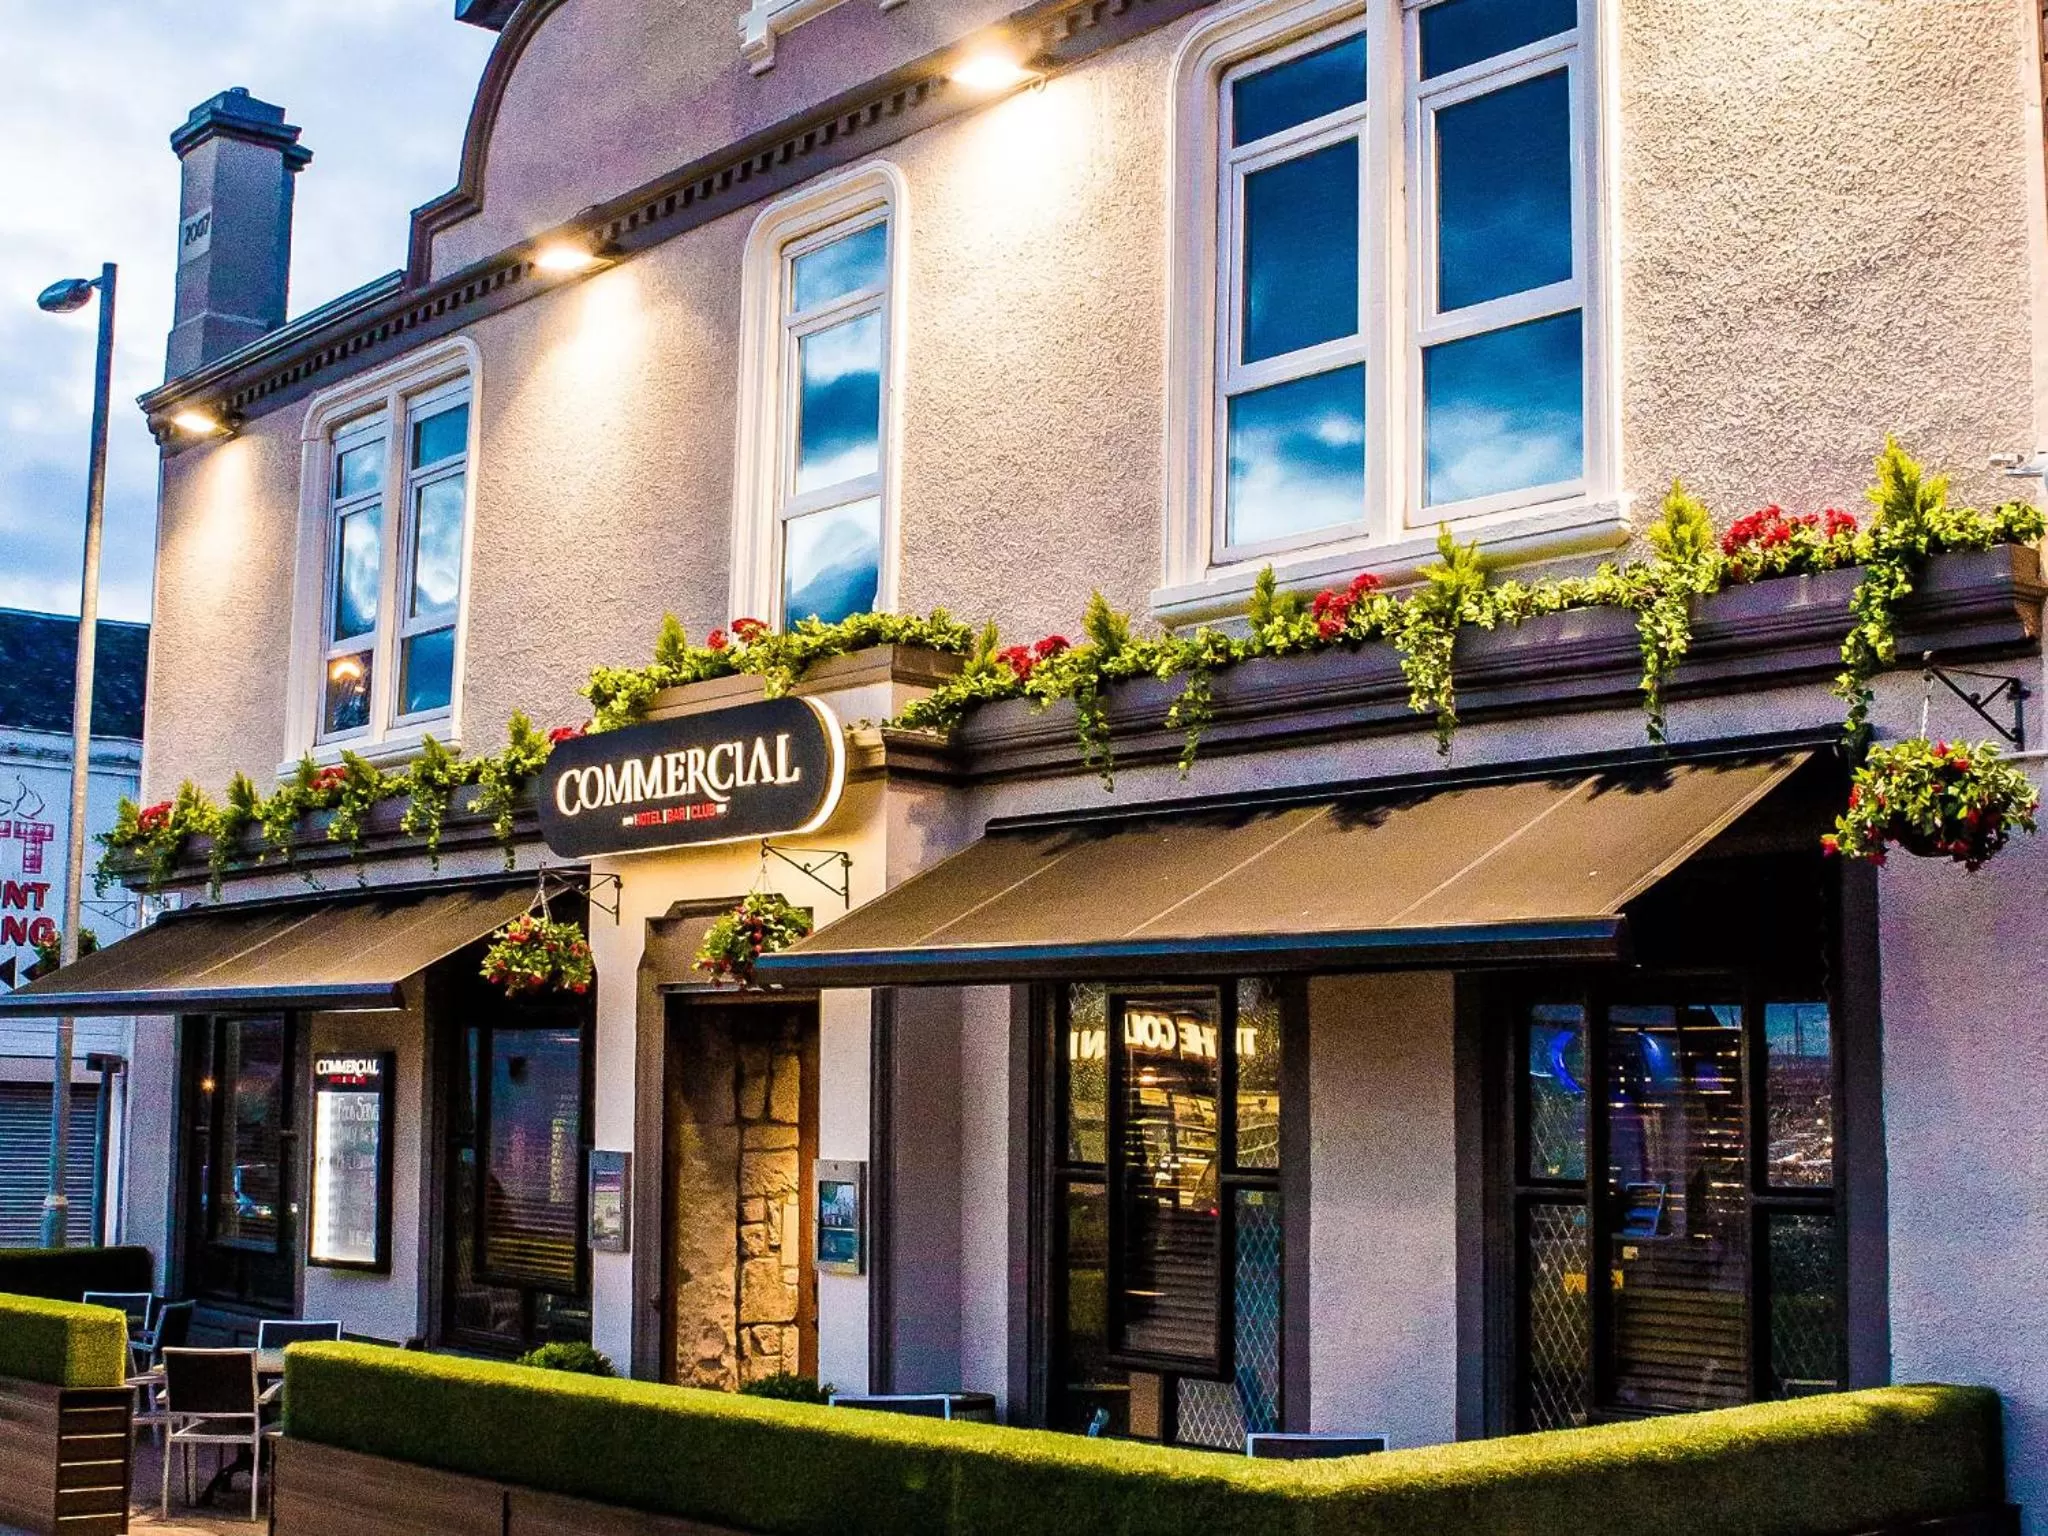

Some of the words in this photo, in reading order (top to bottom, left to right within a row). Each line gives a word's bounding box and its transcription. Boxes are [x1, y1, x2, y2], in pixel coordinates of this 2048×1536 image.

[185, 212, 211, 246] 2007
[557, 733, 801, 817] COMMERCIAL
[634, 811, 662, 827] HOTEL
[667, 807, 685, 822] BAR
[691, 803, 716, 819] CLUB
[316, 1059, 379, 1077] COMMERCIAL
